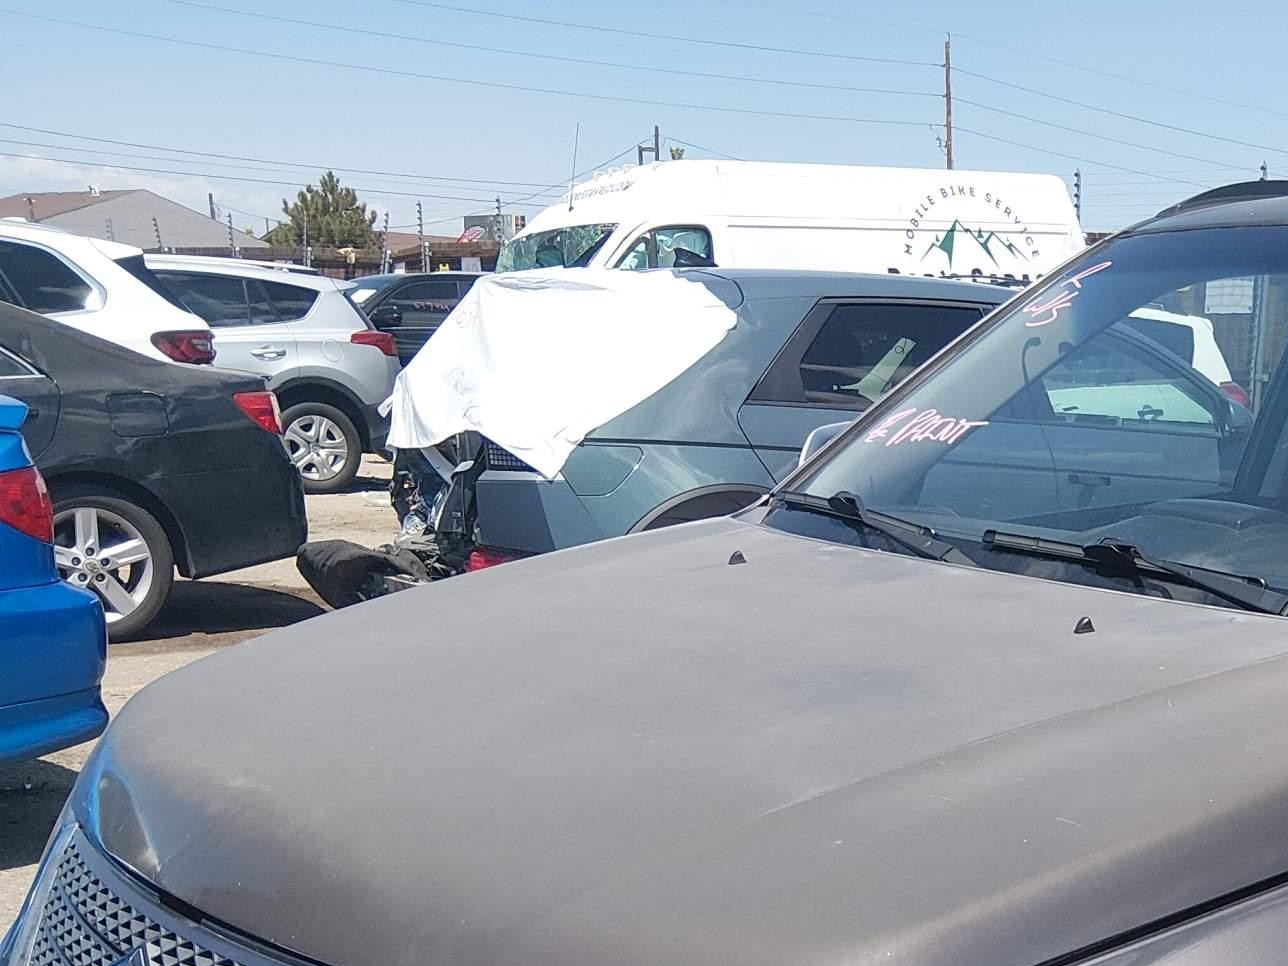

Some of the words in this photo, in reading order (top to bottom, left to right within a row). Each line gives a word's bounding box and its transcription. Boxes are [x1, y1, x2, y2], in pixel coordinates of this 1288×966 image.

[903, 193, 936, 256] MOBILE
[939, 185, 977, 199] BIKE
[983, 192, 1040, 259] SERVICE
